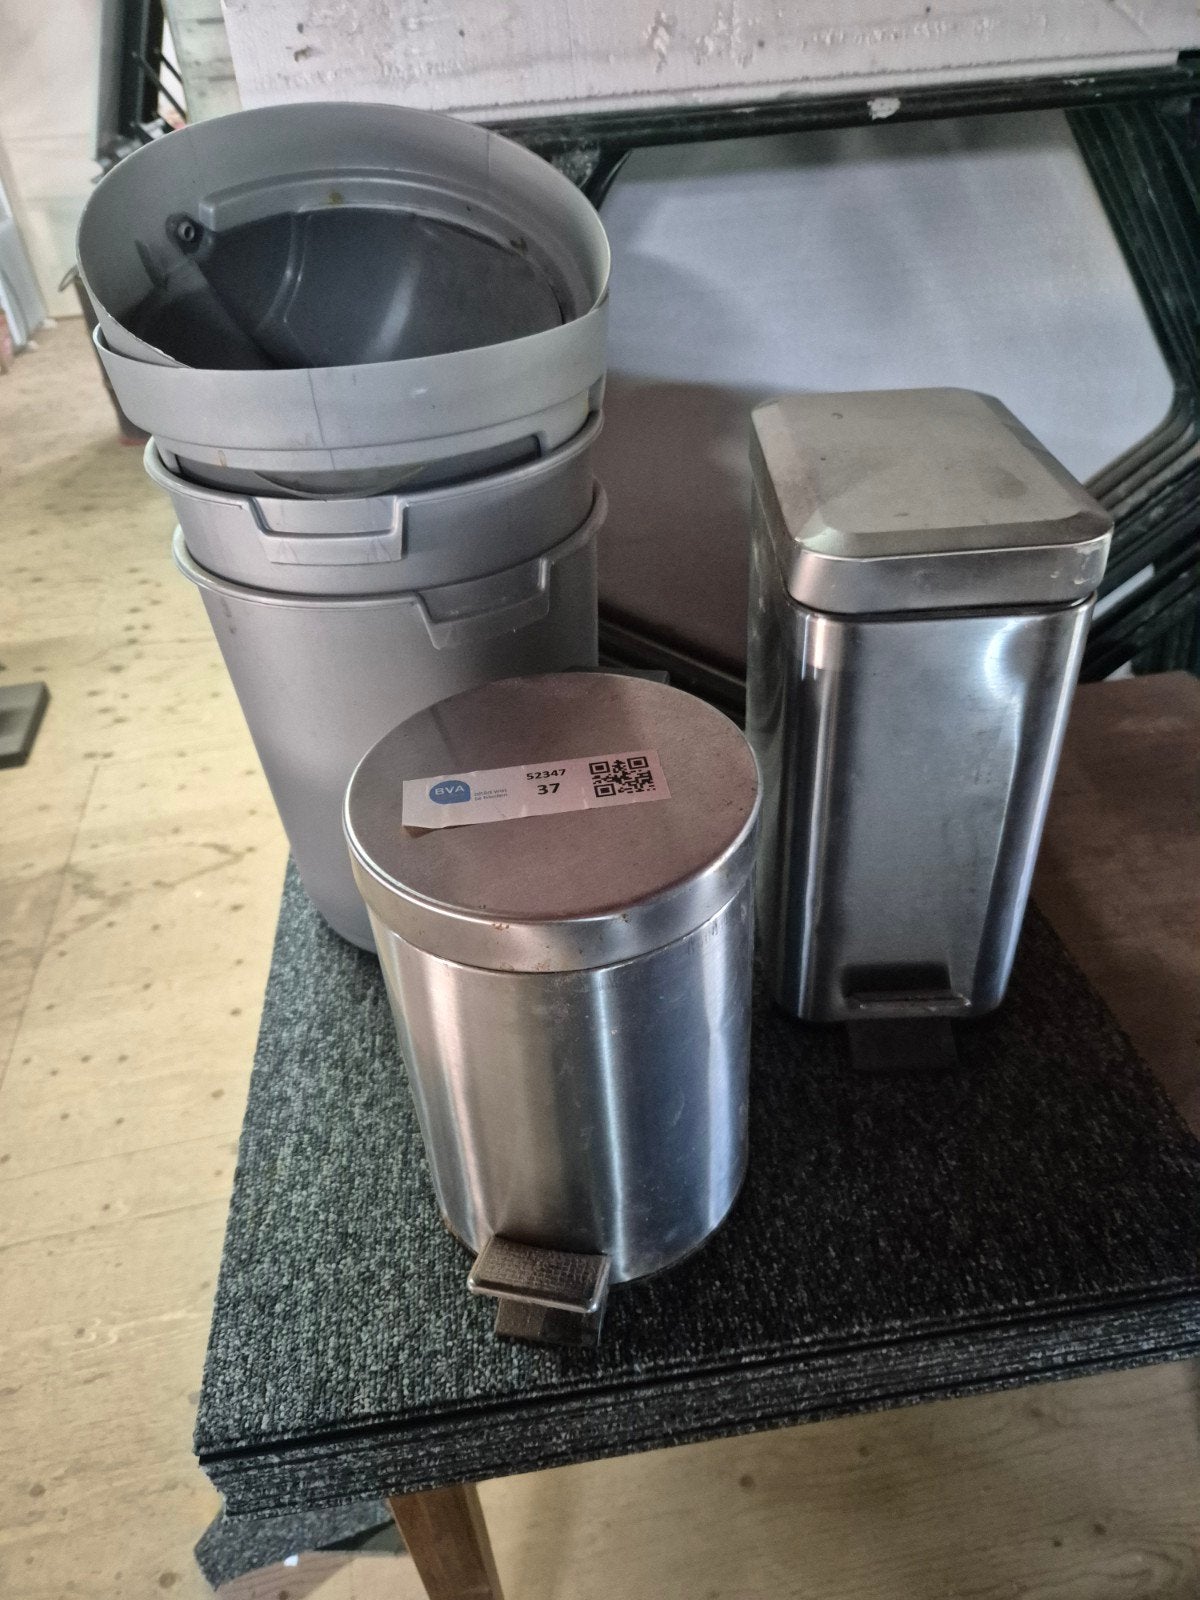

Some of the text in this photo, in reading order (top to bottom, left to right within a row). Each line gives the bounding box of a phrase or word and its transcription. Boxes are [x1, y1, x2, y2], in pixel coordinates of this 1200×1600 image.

[526, 769, 566, 780] 52347
[434, 785, 465, 796] BVA
[537, 783, 560, 795] 37
